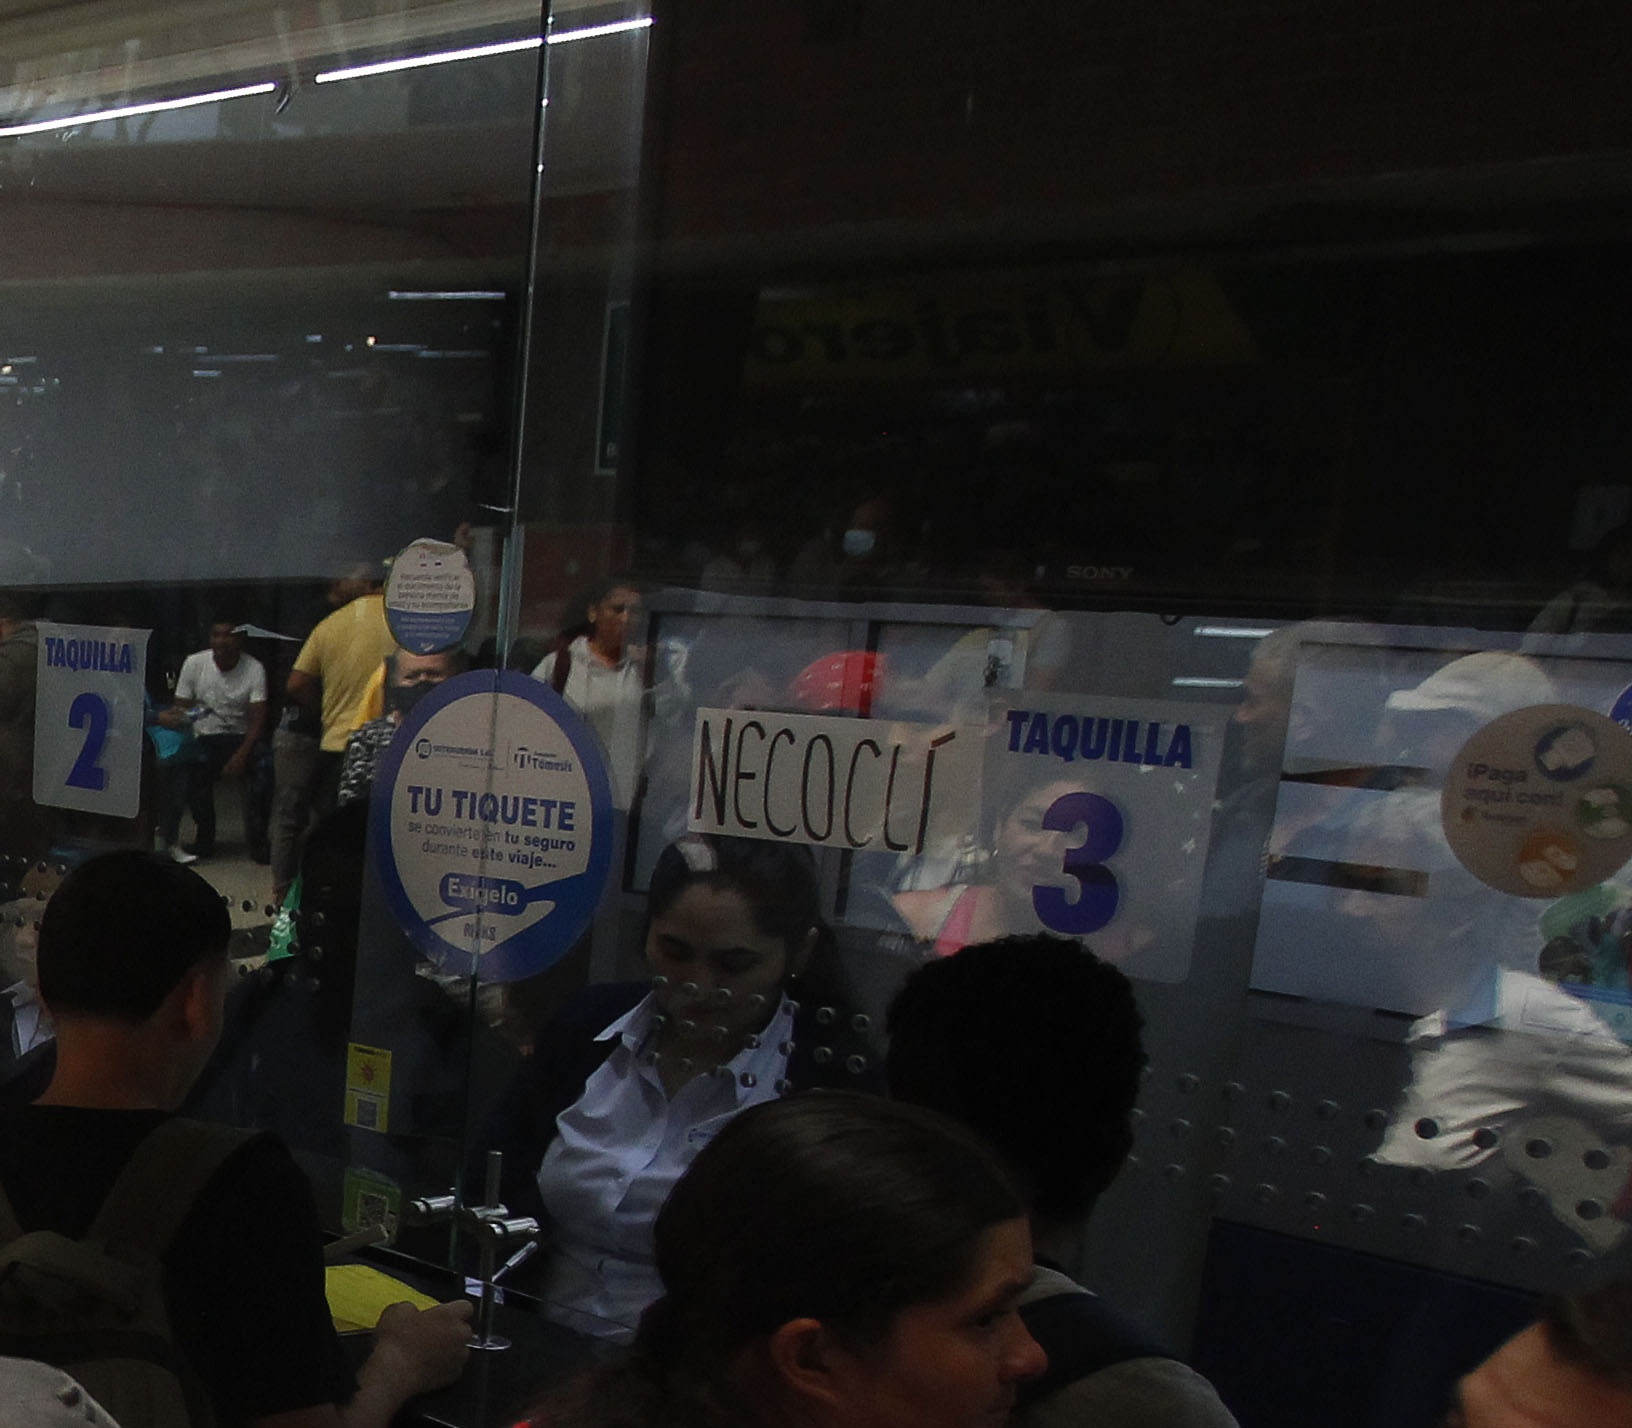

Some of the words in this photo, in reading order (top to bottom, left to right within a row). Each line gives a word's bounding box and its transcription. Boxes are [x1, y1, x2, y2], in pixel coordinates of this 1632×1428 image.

[1065, 565, 1136, 580] SONY
[45, 637, 132, 674] TAQUILLA
[65, 693, 109, 791] 2
[1007, 709, 1194, 769] TAQUILLA
[407, 786, 443, 817] TU
[452, 789, 577, 831] TIQUETE
[695, 718, 956, 855] NECOCLÍ
[407, 821, 423, 834] se
[425, 822, 482, 843] convierte
[505, 831, 520, 845] tu
[524, 833, 576, 853] seguro
[422, 840, 468, 858] durante
[508, 849, 556, 870] viaje...
[1031, 792, 1126, 936] 3
